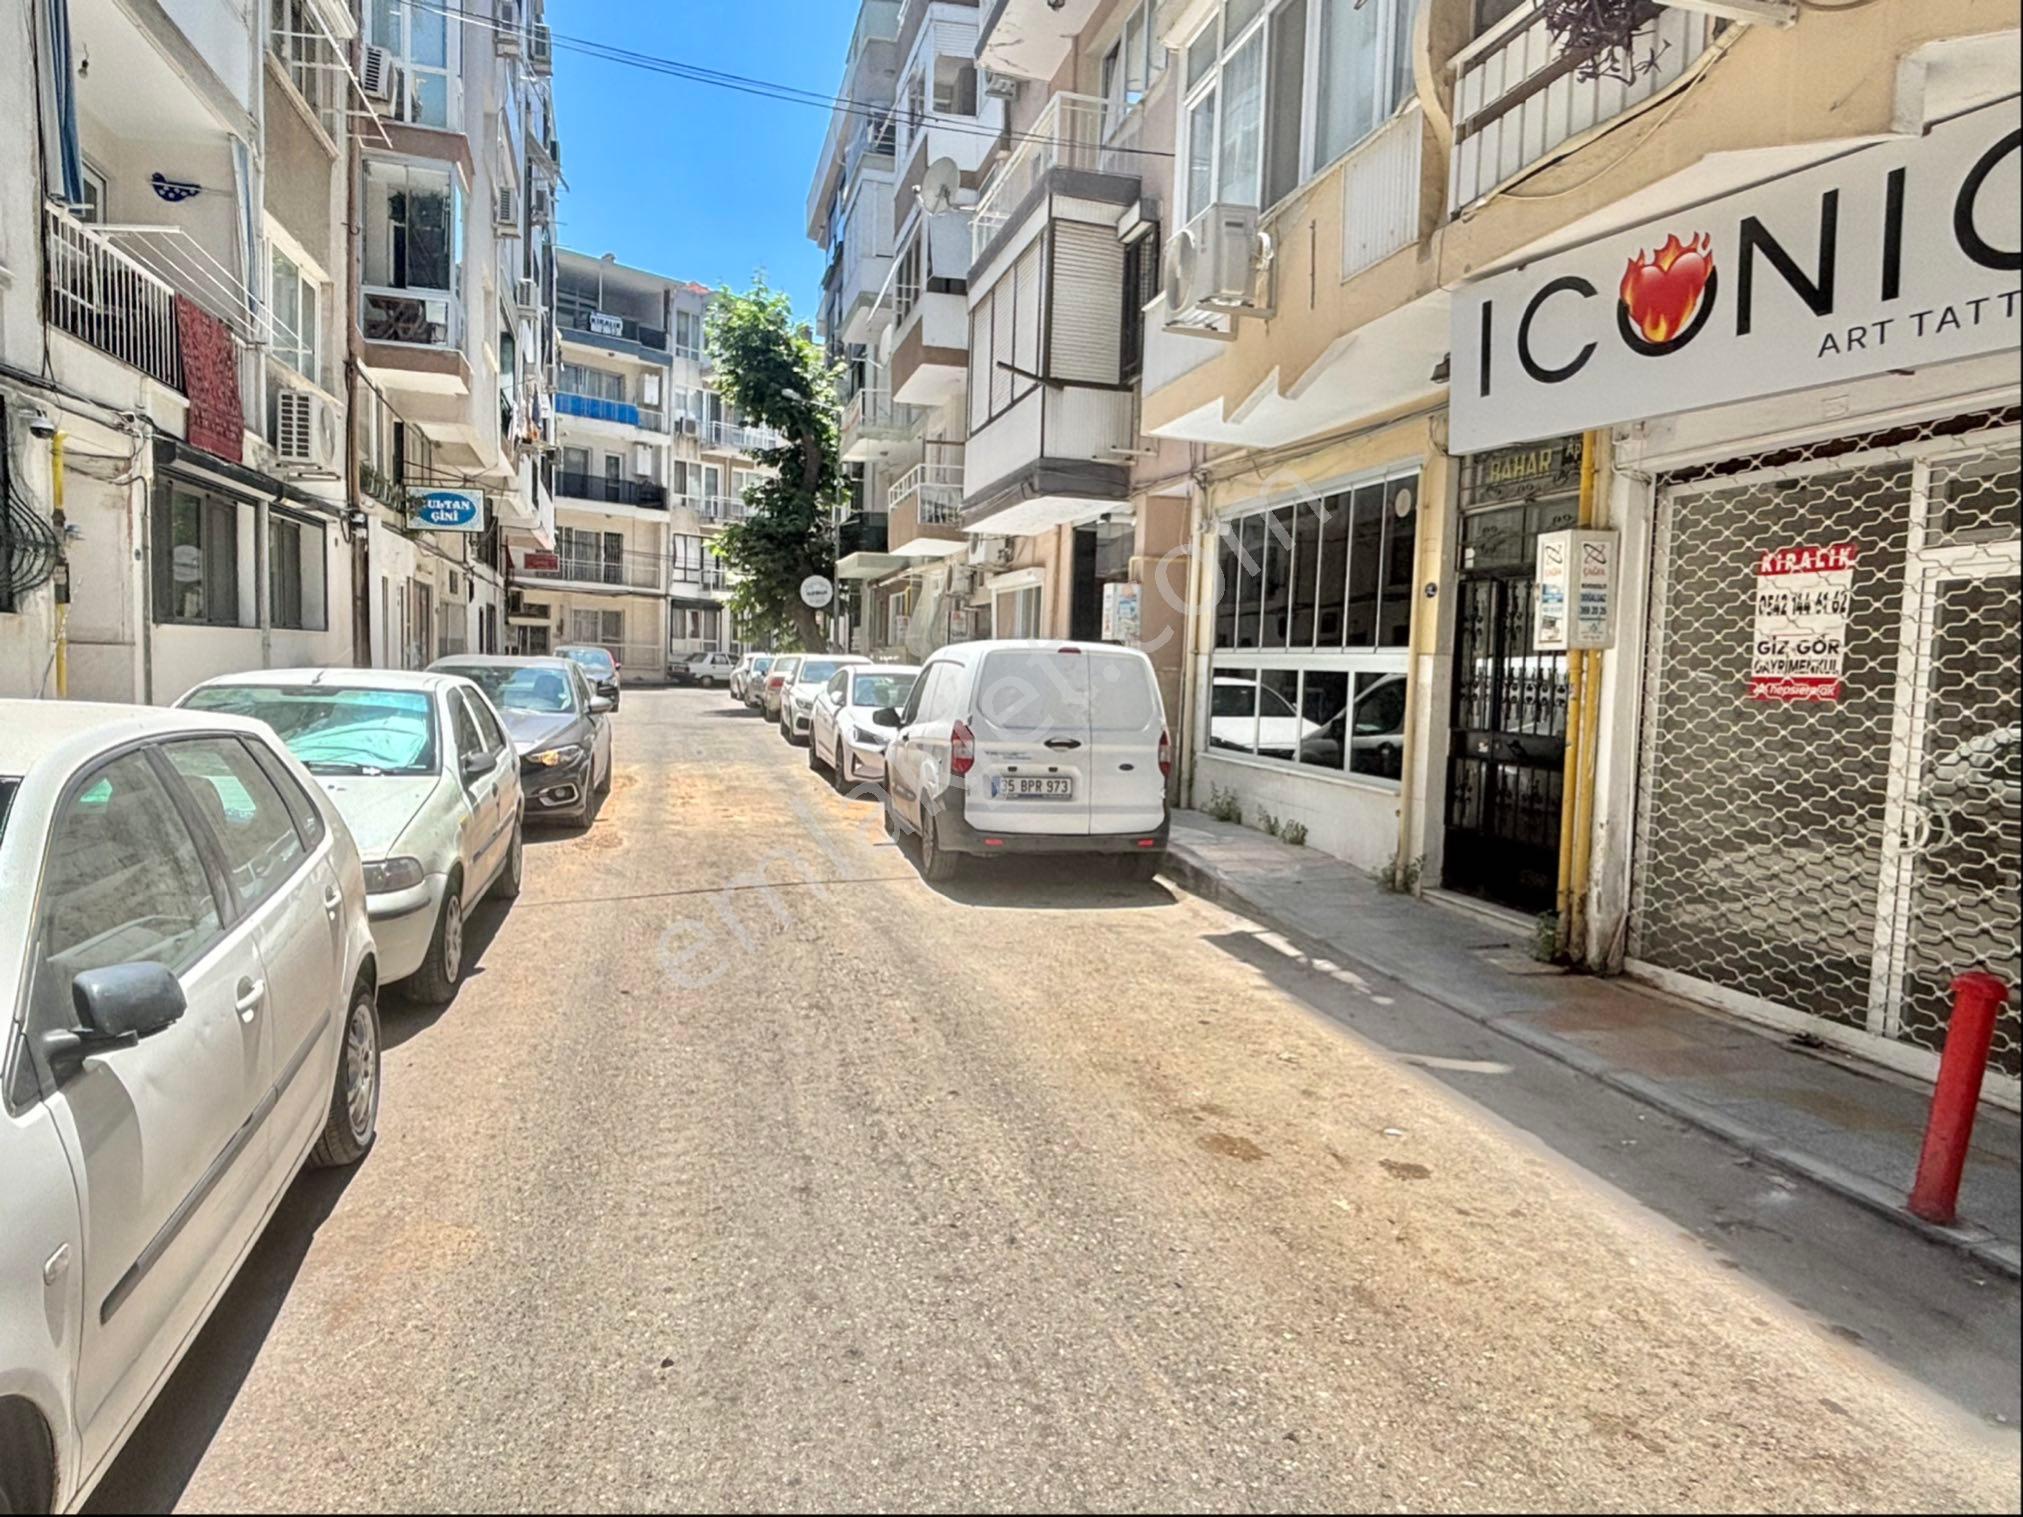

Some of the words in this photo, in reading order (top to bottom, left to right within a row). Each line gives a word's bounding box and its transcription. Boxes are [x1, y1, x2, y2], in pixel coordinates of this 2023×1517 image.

[1480, 127, 2021, 397] ICONIC
[1818, 319, 1895, 358] ART
[1909, 289, 2021, 338] TATT
[1489, 448, 1552, 482] BAHAR
[417, 499, 470, 511] ULTAN
[1757, 635, 1789, 655] GİZ
[1797, 633, 1840, 655] GÖR
[1020, 779, 1042, 793] BPR
[1046, 779, 1069, 793] 973
